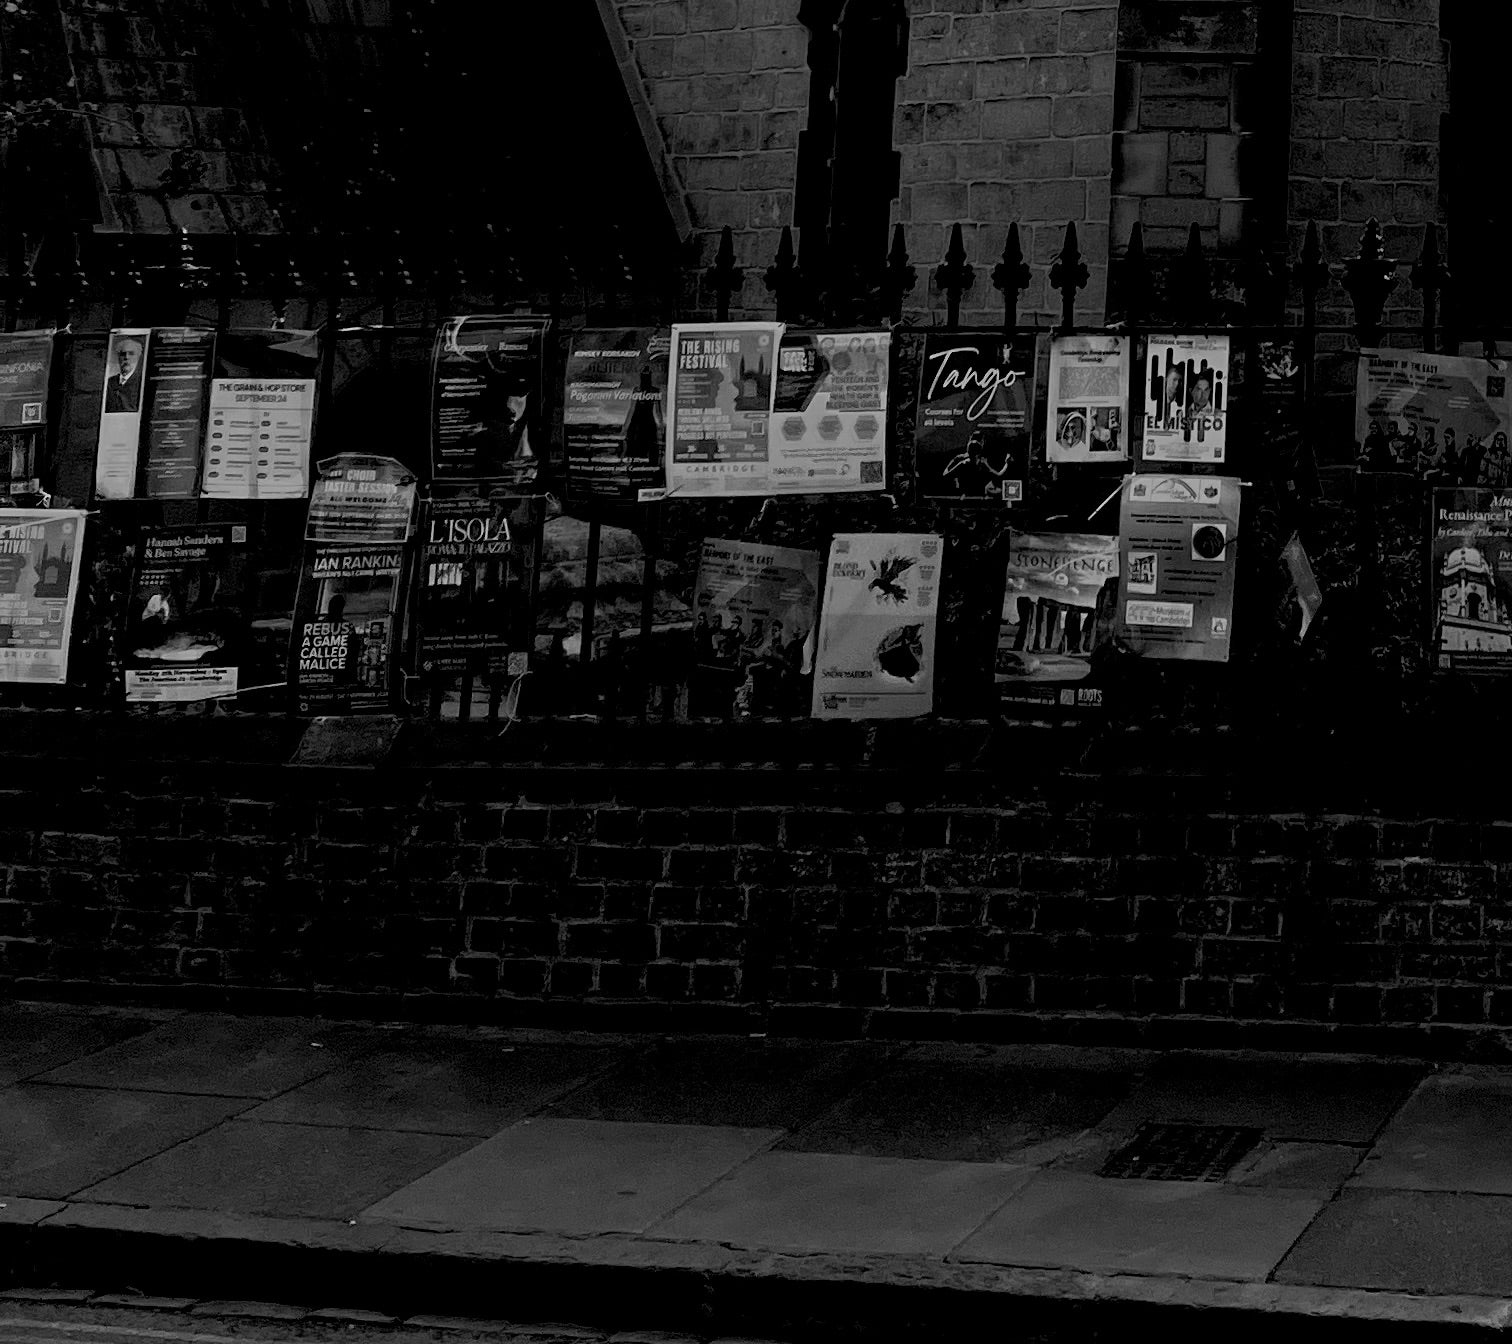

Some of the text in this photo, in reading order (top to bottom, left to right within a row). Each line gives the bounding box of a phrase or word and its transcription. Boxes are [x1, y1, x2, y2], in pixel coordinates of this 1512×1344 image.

[681, 339, 740, 355] THE RISING
[679, 354, 729, 370] FESTIVAL
[219, 384, 232, 392] THE
[281, 384, 306, 392] STORE
[927, 347, 1026, 421] Tango
[570, 390, 662, 403] Paganini Variations
[1439, 508, 1501, 521] Renaissance
[429, 517, 511, 543] L'ISOLA
[146, 534, 224, 548] Hannah Sanders
[313, 557, 338, 572] IAN
[1015, 554, 1114, 573] STONEHENGE
[303, 622, 350, 636] REBUS
[302, 635, 349, 648] A GAME
[300, 647, 348, 659] CALLED
[300, 658, 346, 670] MALICE
